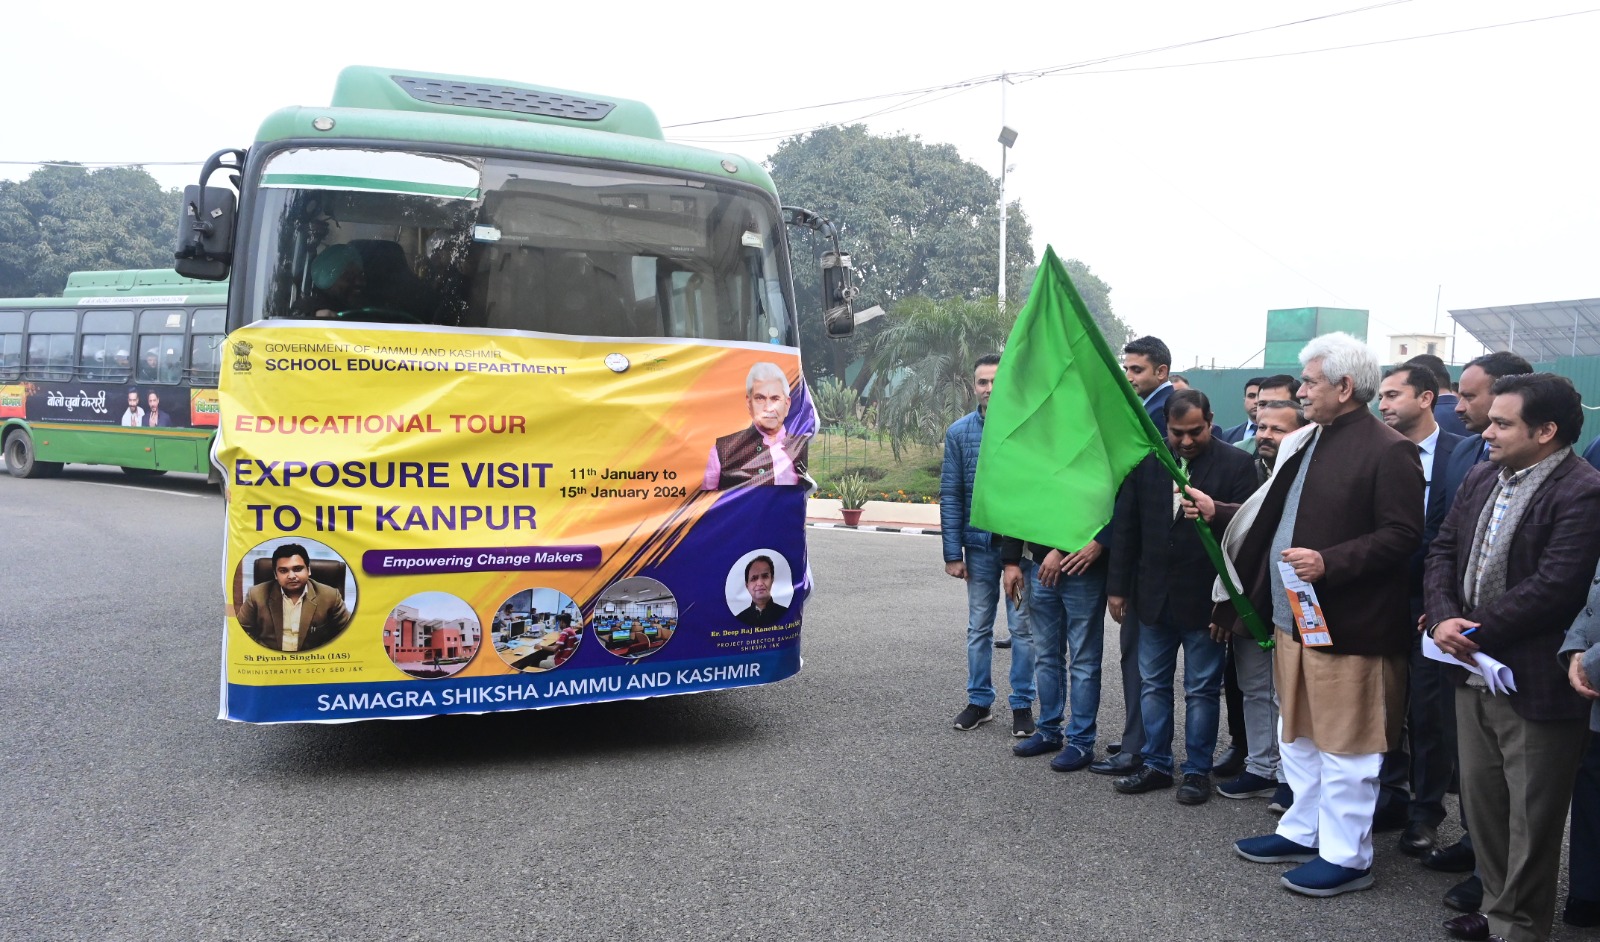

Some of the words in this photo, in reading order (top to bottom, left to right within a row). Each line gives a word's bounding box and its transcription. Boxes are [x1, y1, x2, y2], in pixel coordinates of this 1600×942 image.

[265, 343, 351, 354] GOVERNMENT
[354, 344, 370, 354] OF
[373, 346, 418, 356] JAMMU
[422, 348, 446, 357] AND
[449, 348, 502, 358] KASHMIR
[265, 358, 342, 372] SCHOOL
[347, 358, 451, 372] EDUCATION
[454, 361, 568, 374] DEPARTMENT
[47, 390, 64, 407] बोलो
[80, 390, 108, 414] केसरी
[235, 414, 442, 434] EDUCATIONAL
[449, 414, 526, 434] TOUR
[235, 458, 450, 488] EXPOSURE
[461, 462, 554, 488] VISIT
[570, 468, 597, 480] 11th
[600, 468, 659, 484] January
[662, 469, 678, 480] to
[560, 486, 587, 498] 15th
[590, 486, 650, 500] January
[654, 486, 687, 498] 2024
[247, 504, 302, 532] TO
[316, 505, 363, 532] IIT
[376, 505, 537, 532] KANPUR
[383, 555, 474, 569] Empowering
[477, 553, 530, 567] Change
[534, 552, 584, 564] Makers
[256, 654, 288, 663] Piyush
[289, 652, 326, 662] Singhla
[326, 652, 351, 661] (IAS)
[237, 668, 302, 676] ADMINISTRATIVE
[317, 691, 436, 712] SAMAGRA
[441, 680, 540, 706] SHIKSHA
[543, 675, 622, 699] JAMMU
[626, 671, 672, 690] AND
[676, 662, 761, 684] KASHMIR
